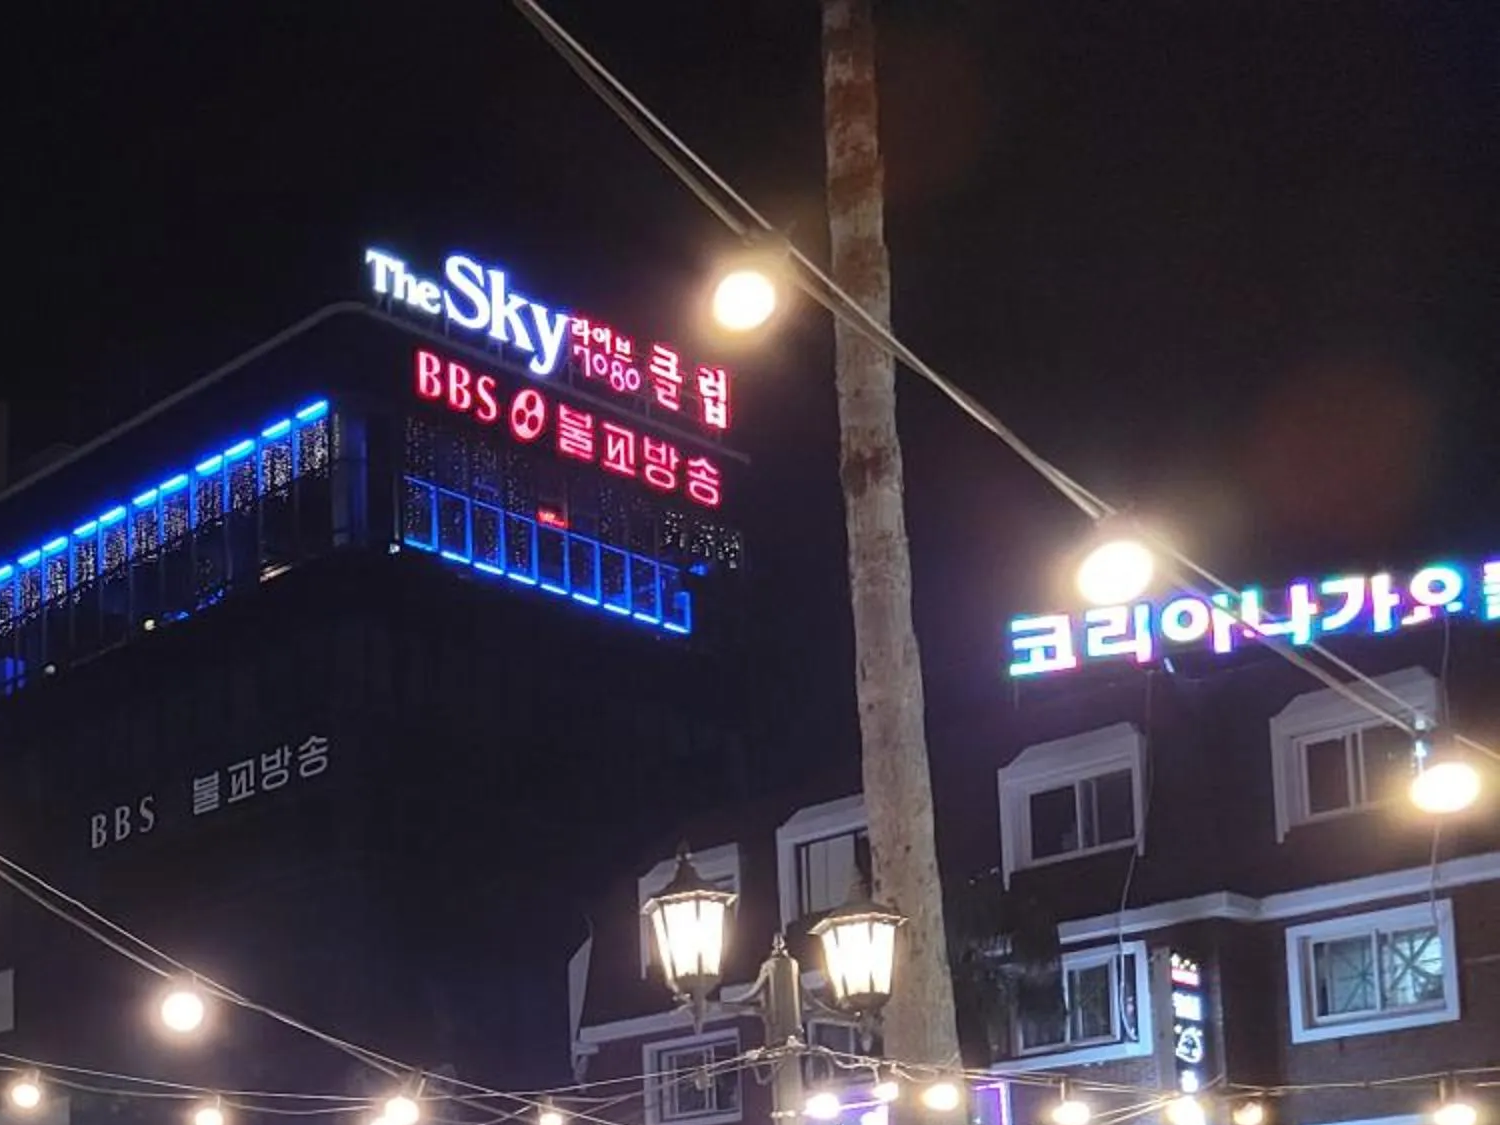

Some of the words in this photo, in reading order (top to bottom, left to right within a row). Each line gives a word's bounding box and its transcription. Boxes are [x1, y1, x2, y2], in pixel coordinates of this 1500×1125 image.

[365, 249, 441, 315] The
[443, 254, 571, 375] Sky
[571, 316, 633, 363] 라이브
[572, 344, 641, 392] 7080
[415, 350, 497, 423] BBS
[558, 403, 720, 507] 불교방송
[90, 796, 155, 849] BBS
[192, 735, 329, 815] 불교방송
